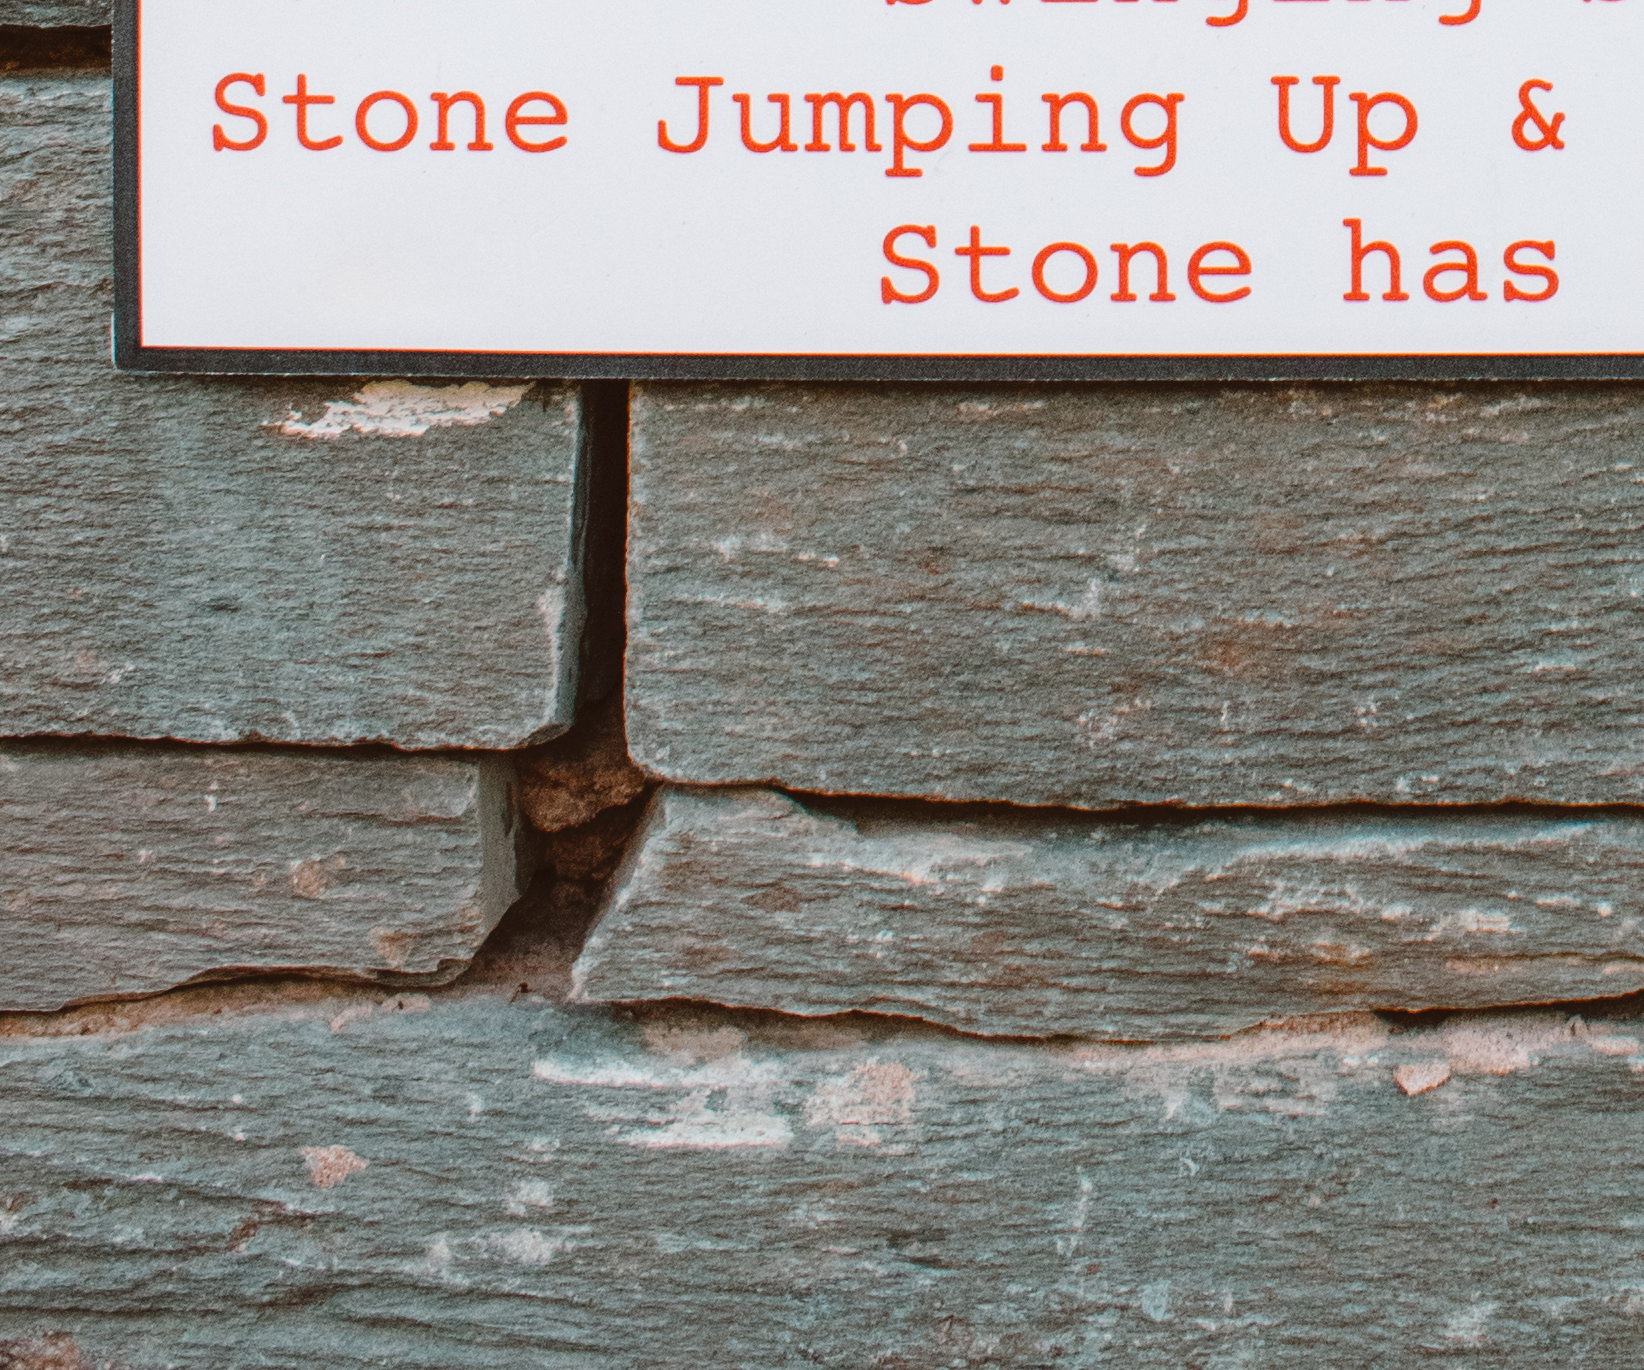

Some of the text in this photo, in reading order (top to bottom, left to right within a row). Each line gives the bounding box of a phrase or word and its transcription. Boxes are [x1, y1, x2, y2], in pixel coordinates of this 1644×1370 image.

[212, 71, 569, 154] Stone
[657, 64, 1186, 178] Jumping
[1270, 74, 1419, 177] Up
[1511, 77, 1566, 152] &
[880, 223, 1253, 305] Stone
[1342, 216, 1560, 303] has
